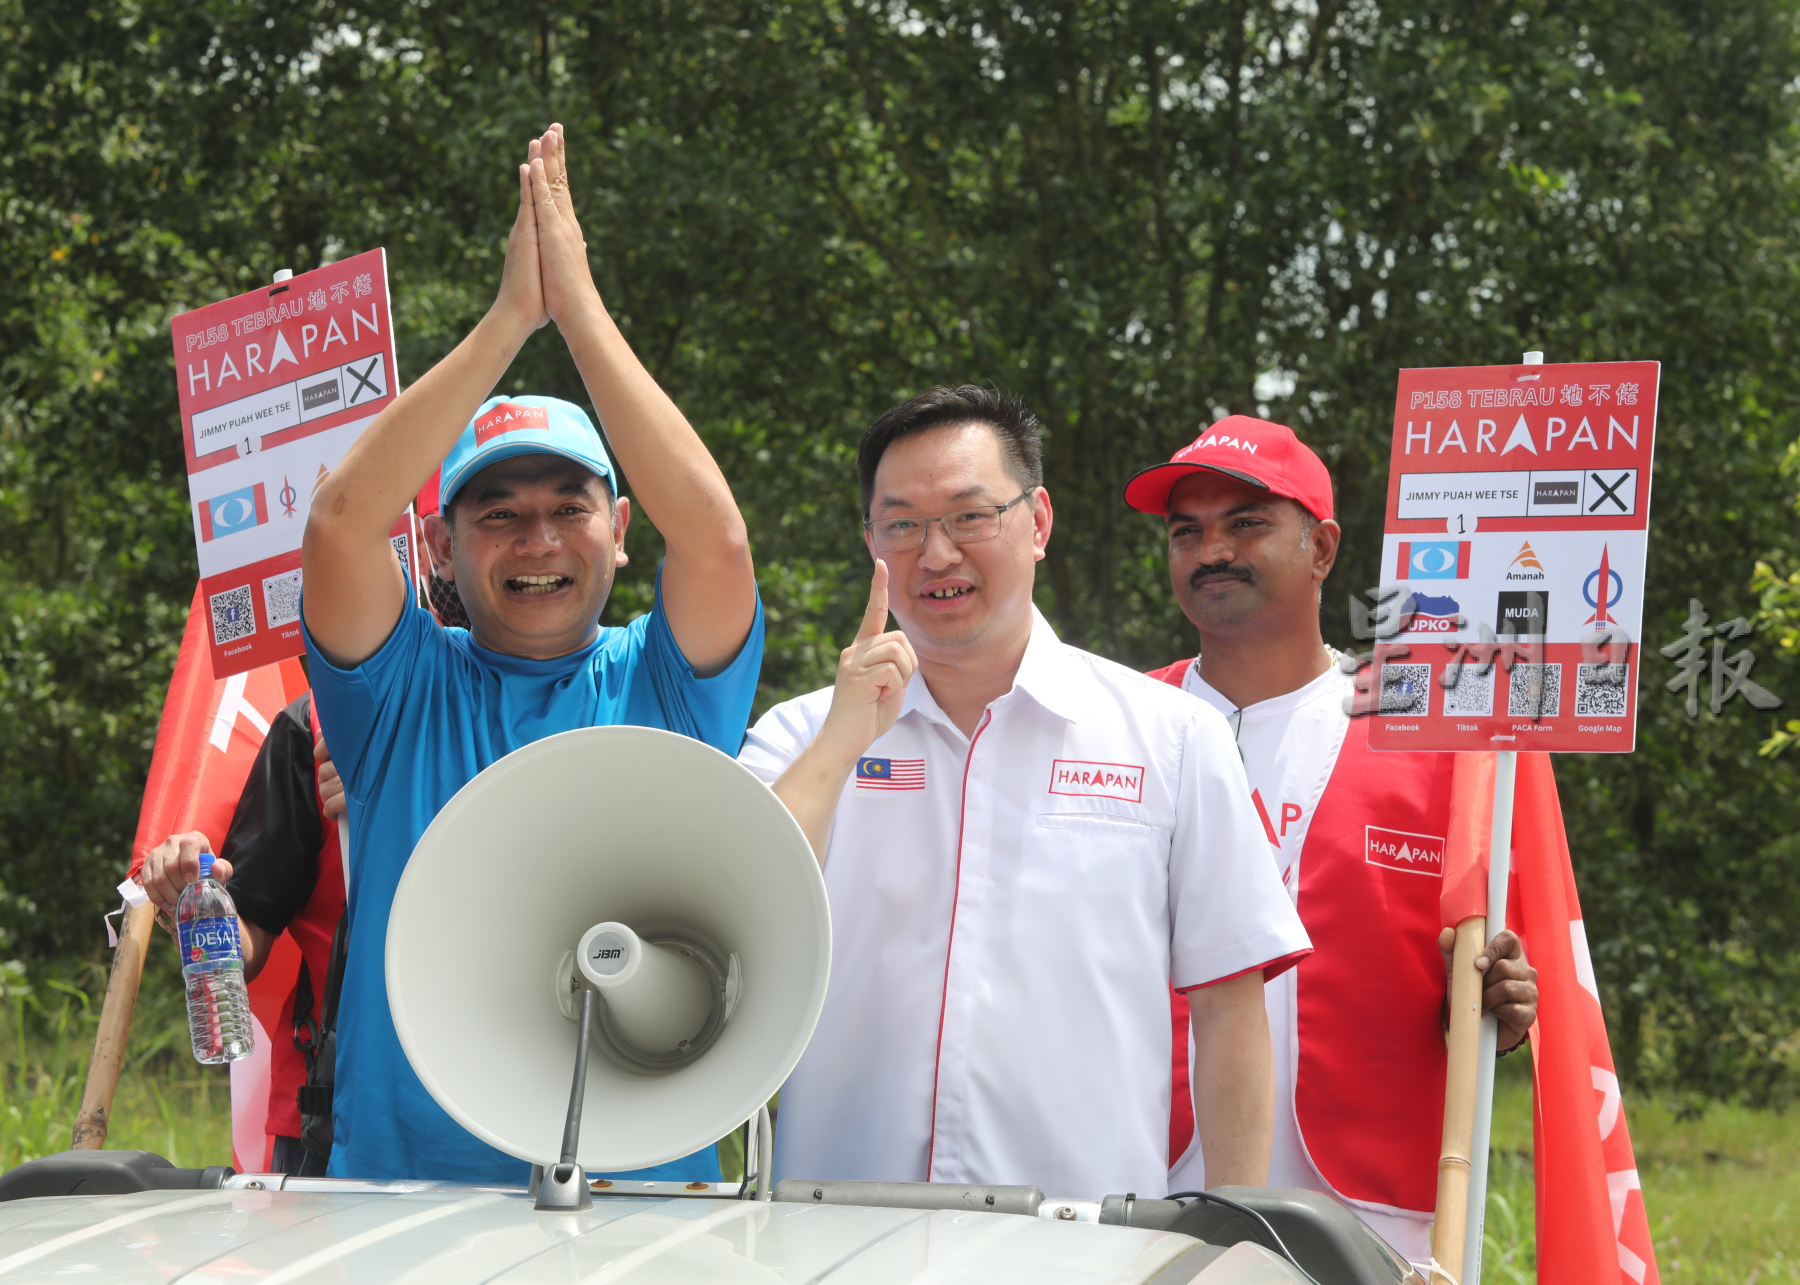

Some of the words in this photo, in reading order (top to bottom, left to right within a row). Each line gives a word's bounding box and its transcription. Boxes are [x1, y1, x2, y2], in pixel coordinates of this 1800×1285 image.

[185, 324, 228, 352] P158
[231, 298, 304, 337] TEBRAU
[187, 302, 379, 397] HARAPAN
[304, 387, 337, 403] HARAPAN
[1410, 390, 1462, 409] P158
[1467, 387, 1555, 408] TEBRAU
[199, 421, 227, 439] JIMMY
[229, 414, 254, 430] PUAH
[254, 407, 274, 423] WEE
[275, 401, 291, 416] TSE
[477, 409, 544, 435] HARAPAN
[1405, 413, 1639, 457] HARAPAN
[244, 436, 252, 455] 1
[1405, 490, 1441, 501] JIMMY
[1443, 490, 1473, 500] PUAH
[1474, 490, 1498, 500] WEE
[1500, 489, 1519, 499] TSE
[1536, 488, 1576, 498] HARAPAN
[1457, 513, 1467, 534] 1
[1505, 571, 1545, 581] Amanah
[1504, 607, 1540, 618] MUDA
[1408, 619, 1451, 631] UPKO
[281, 628, 300, 640] Tiktok
[223, 643, 253, 658] Facebook
[1385, 723, 1420, 731] Facebook
[1456, 723, 1479, 731] Tiktok
[1534, 724, 1553, 732] Form
[1578, 724, 1604, 733] Google
[1605, 724, 1622, 733] Map
[1058, 769, 1137, 790] HARAPAN
[1370, 839, 1441, 864] HARAPAN
[195, 929, 232, 948] DESA
